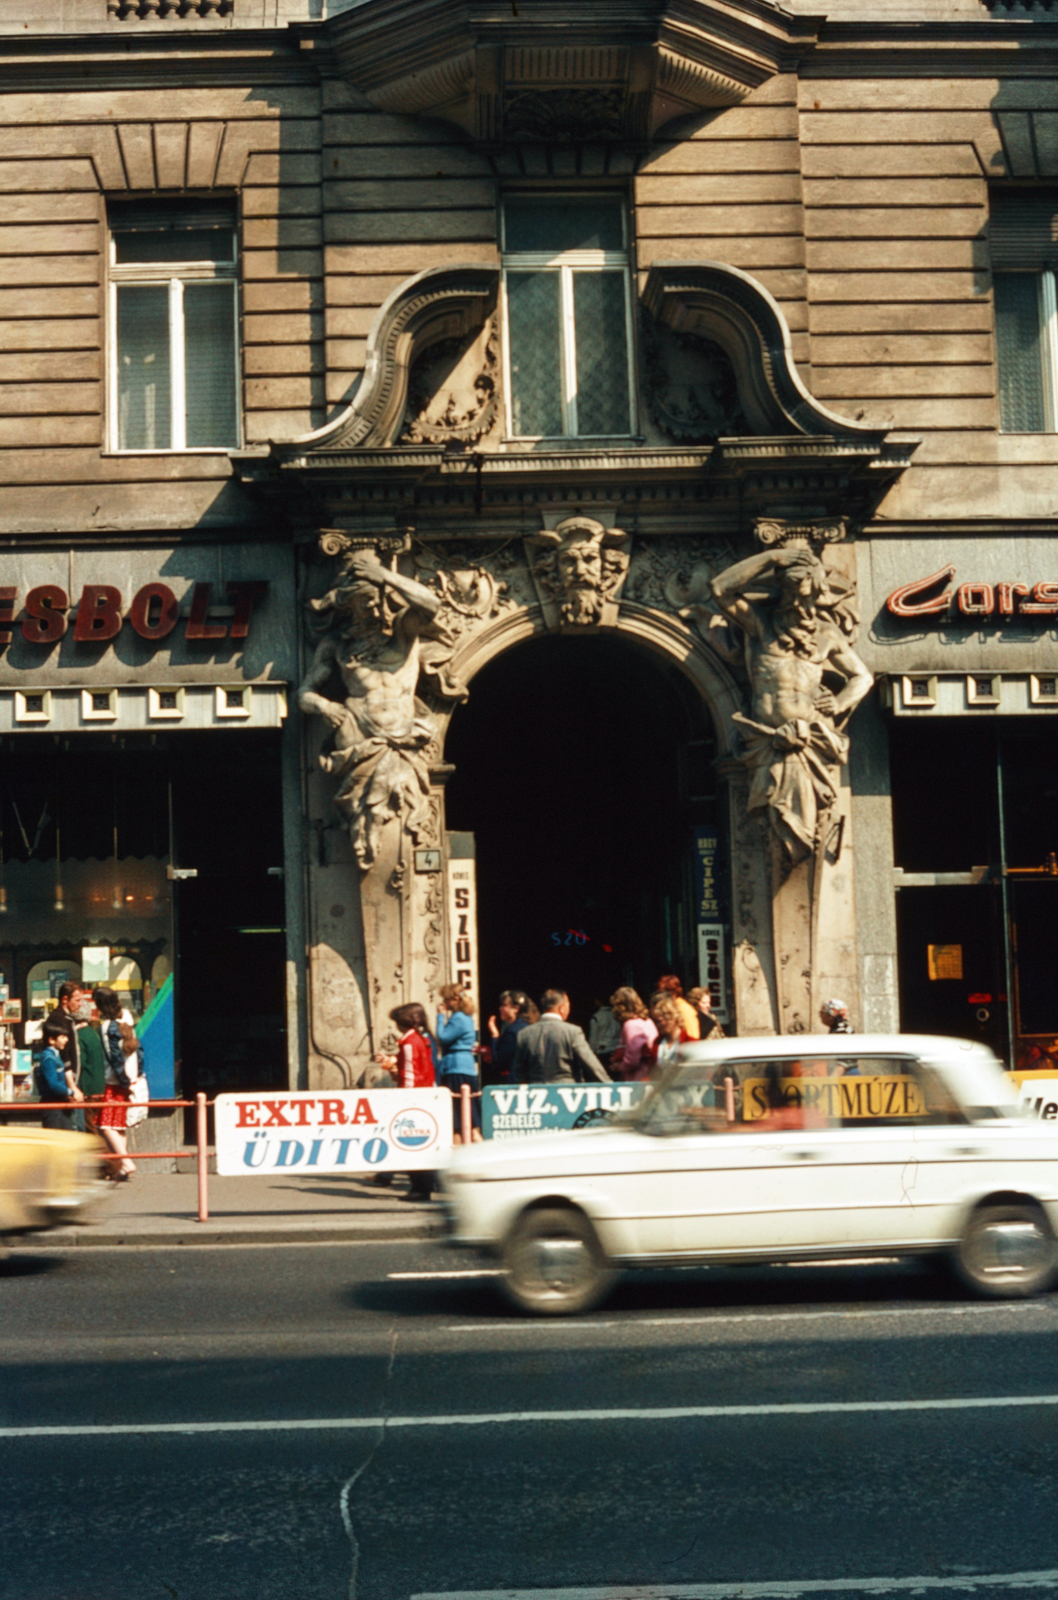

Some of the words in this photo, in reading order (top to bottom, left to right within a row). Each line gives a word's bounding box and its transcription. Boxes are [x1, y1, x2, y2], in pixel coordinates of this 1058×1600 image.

[424, 853, 432, 867] 4
[751, 1076, 926, 1119] SORTMÚZE
[235, 1098, 378, 1128] EXTRA
[492, 1113, 542, 1129] SZERELÉS
[403, 1128, 431, 1136] EXTRA
[243, 1127, 389, 1168] ÜDÍTŐ
